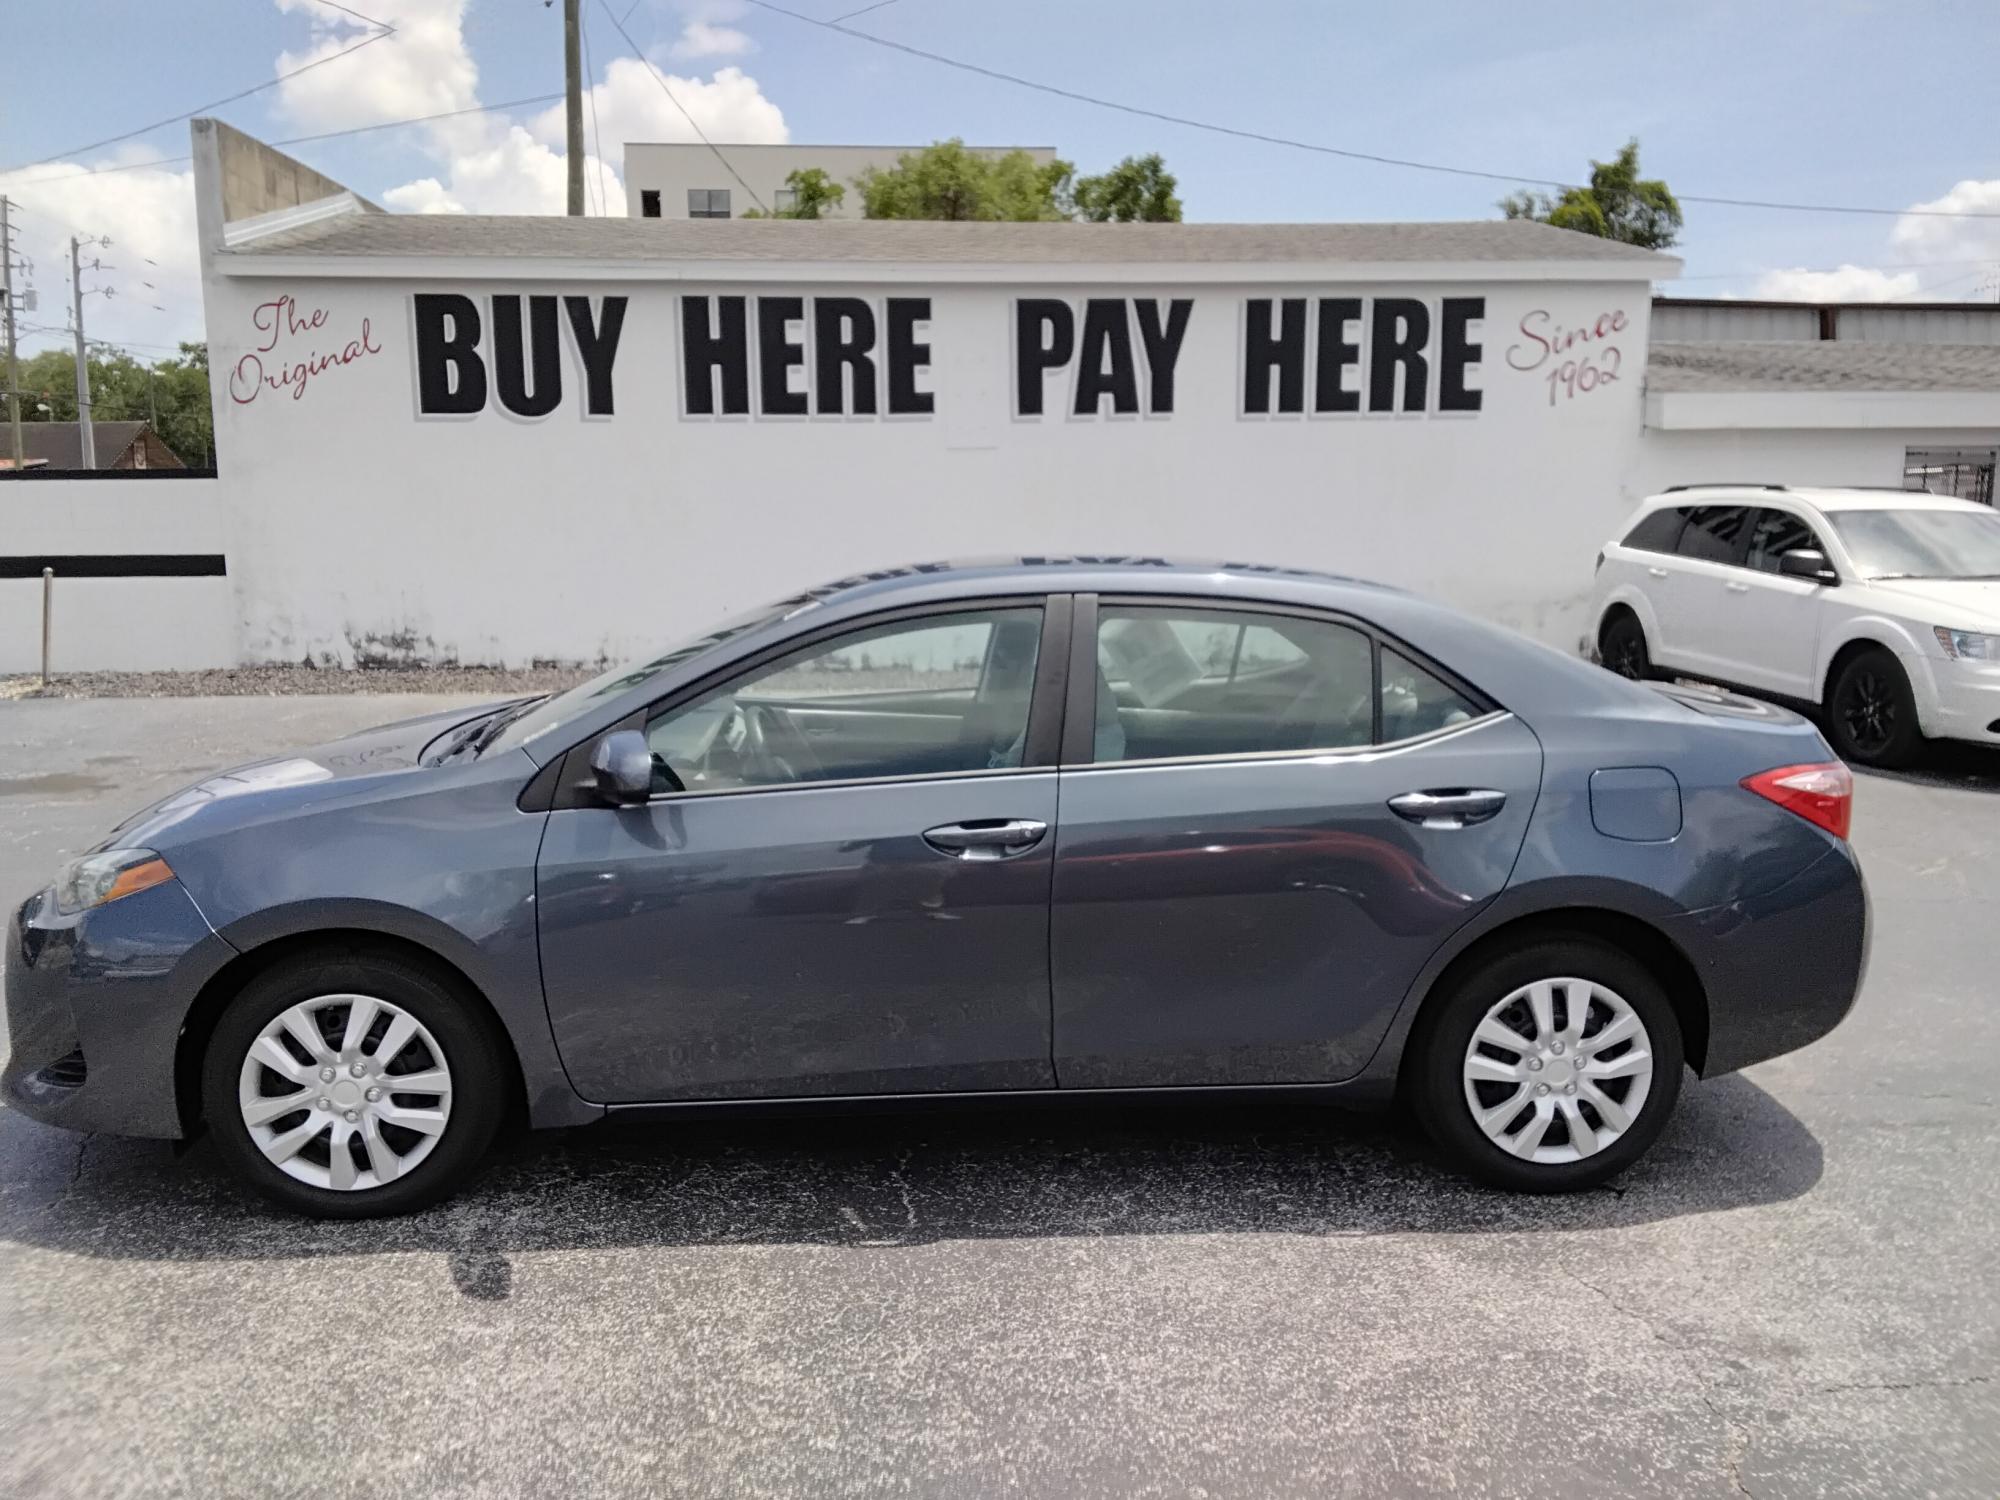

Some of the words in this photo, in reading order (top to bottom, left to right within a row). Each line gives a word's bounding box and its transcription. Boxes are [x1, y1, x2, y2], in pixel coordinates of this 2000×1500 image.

[253, 295, 330, 352] The
[1506, 309, 1629, 371] Since
[229, 319, 382, 404] Original
[411, 293, 629, 418] BUY
[679, 295, 934, 416] HERE
[1014, 298, 1194, 416] PAY
[1242, 297, 1486, 414] HERE
[1546, 347, 1622, 407] 1962
